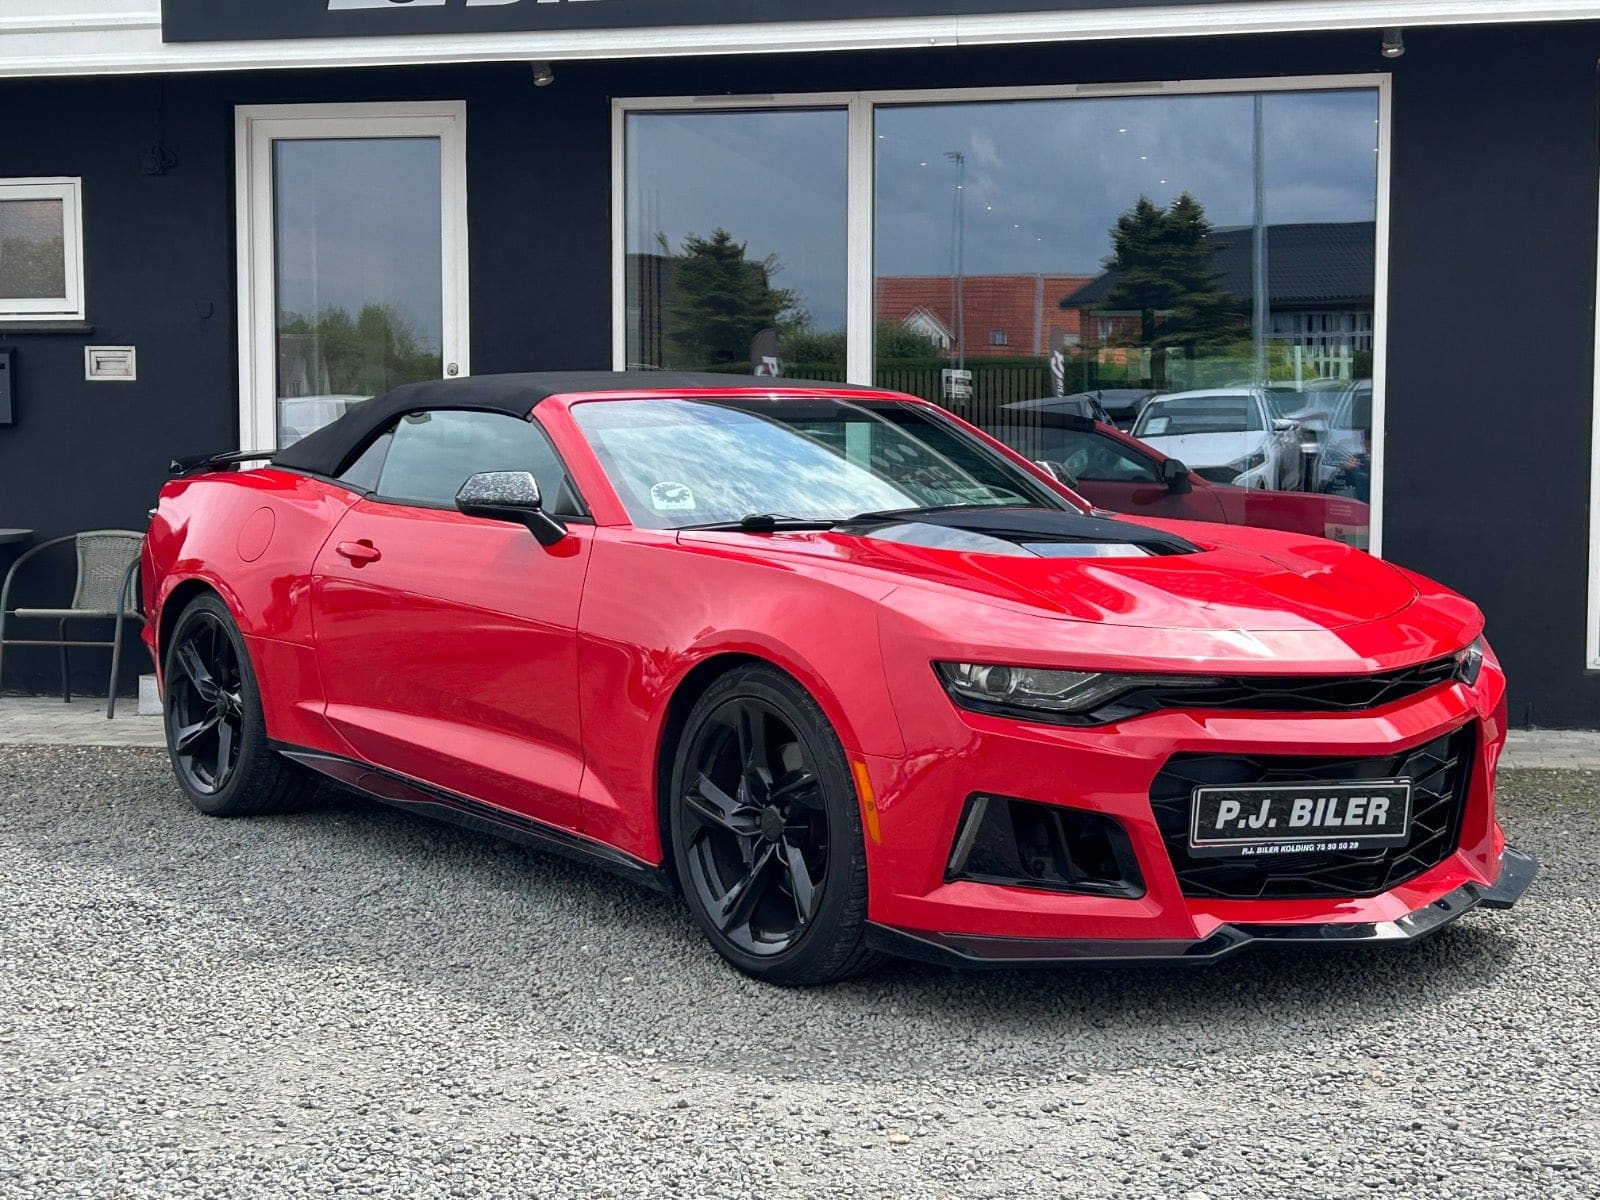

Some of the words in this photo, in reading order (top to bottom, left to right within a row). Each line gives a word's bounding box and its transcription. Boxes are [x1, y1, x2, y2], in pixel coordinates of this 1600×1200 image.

[1215, 800, 1276, 829] P.J.
[1289, 797, 1390, 827] BILER
[1256, 846, 1279, 854] BILER
[1280, 844, 1315, 853] KOLDING
